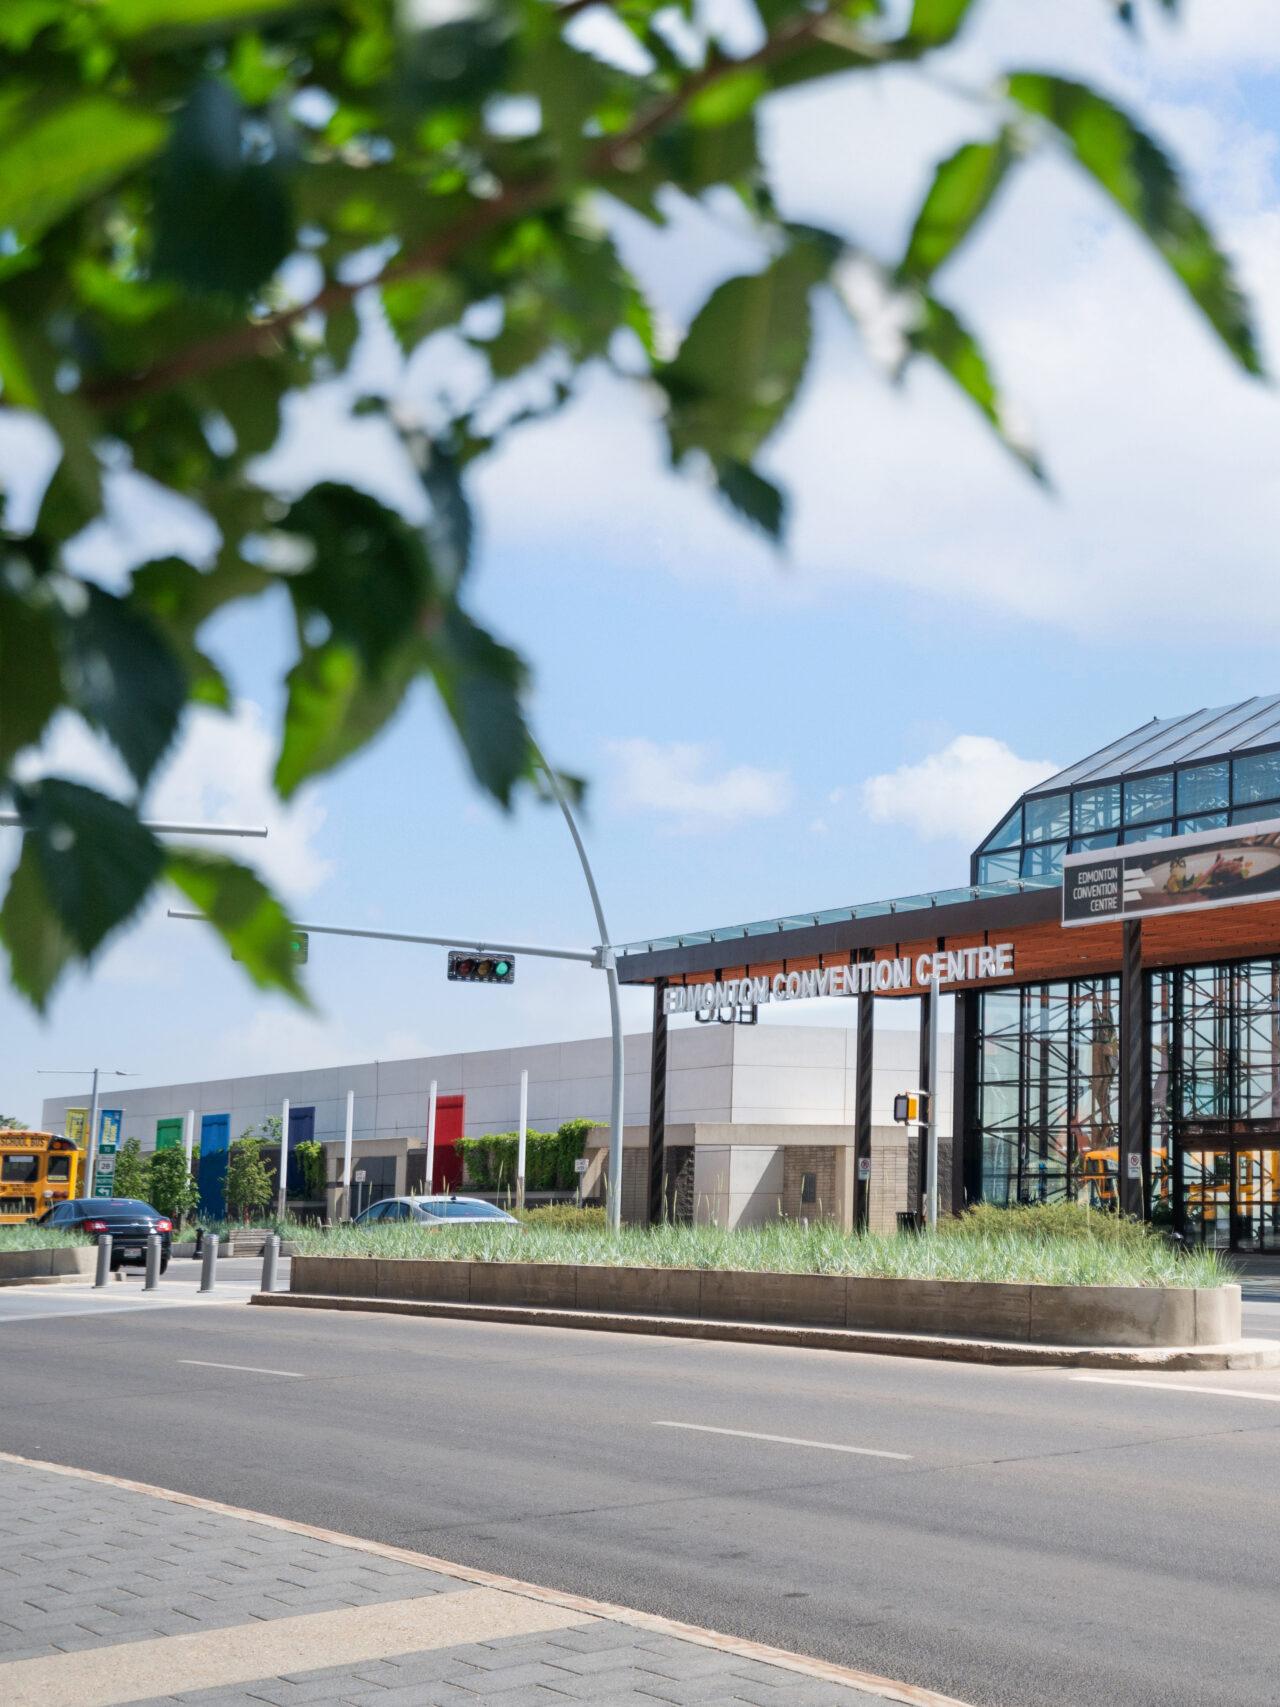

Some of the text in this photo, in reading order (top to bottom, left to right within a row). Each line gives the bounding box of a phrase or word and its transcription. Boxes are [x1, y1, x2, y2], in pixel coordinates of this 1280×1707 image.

[1078, 867, 1118, 885] EDMONTON
[1073, 882, 1118, 900] CONVENTION
[1090, 896, 1118, 912] CENTRE
[663, 975, 771, 1015] EDMONTON
[772, 957, 912, 1001] CONVENTION
[916, 943, 1014, 986] CENTRE
